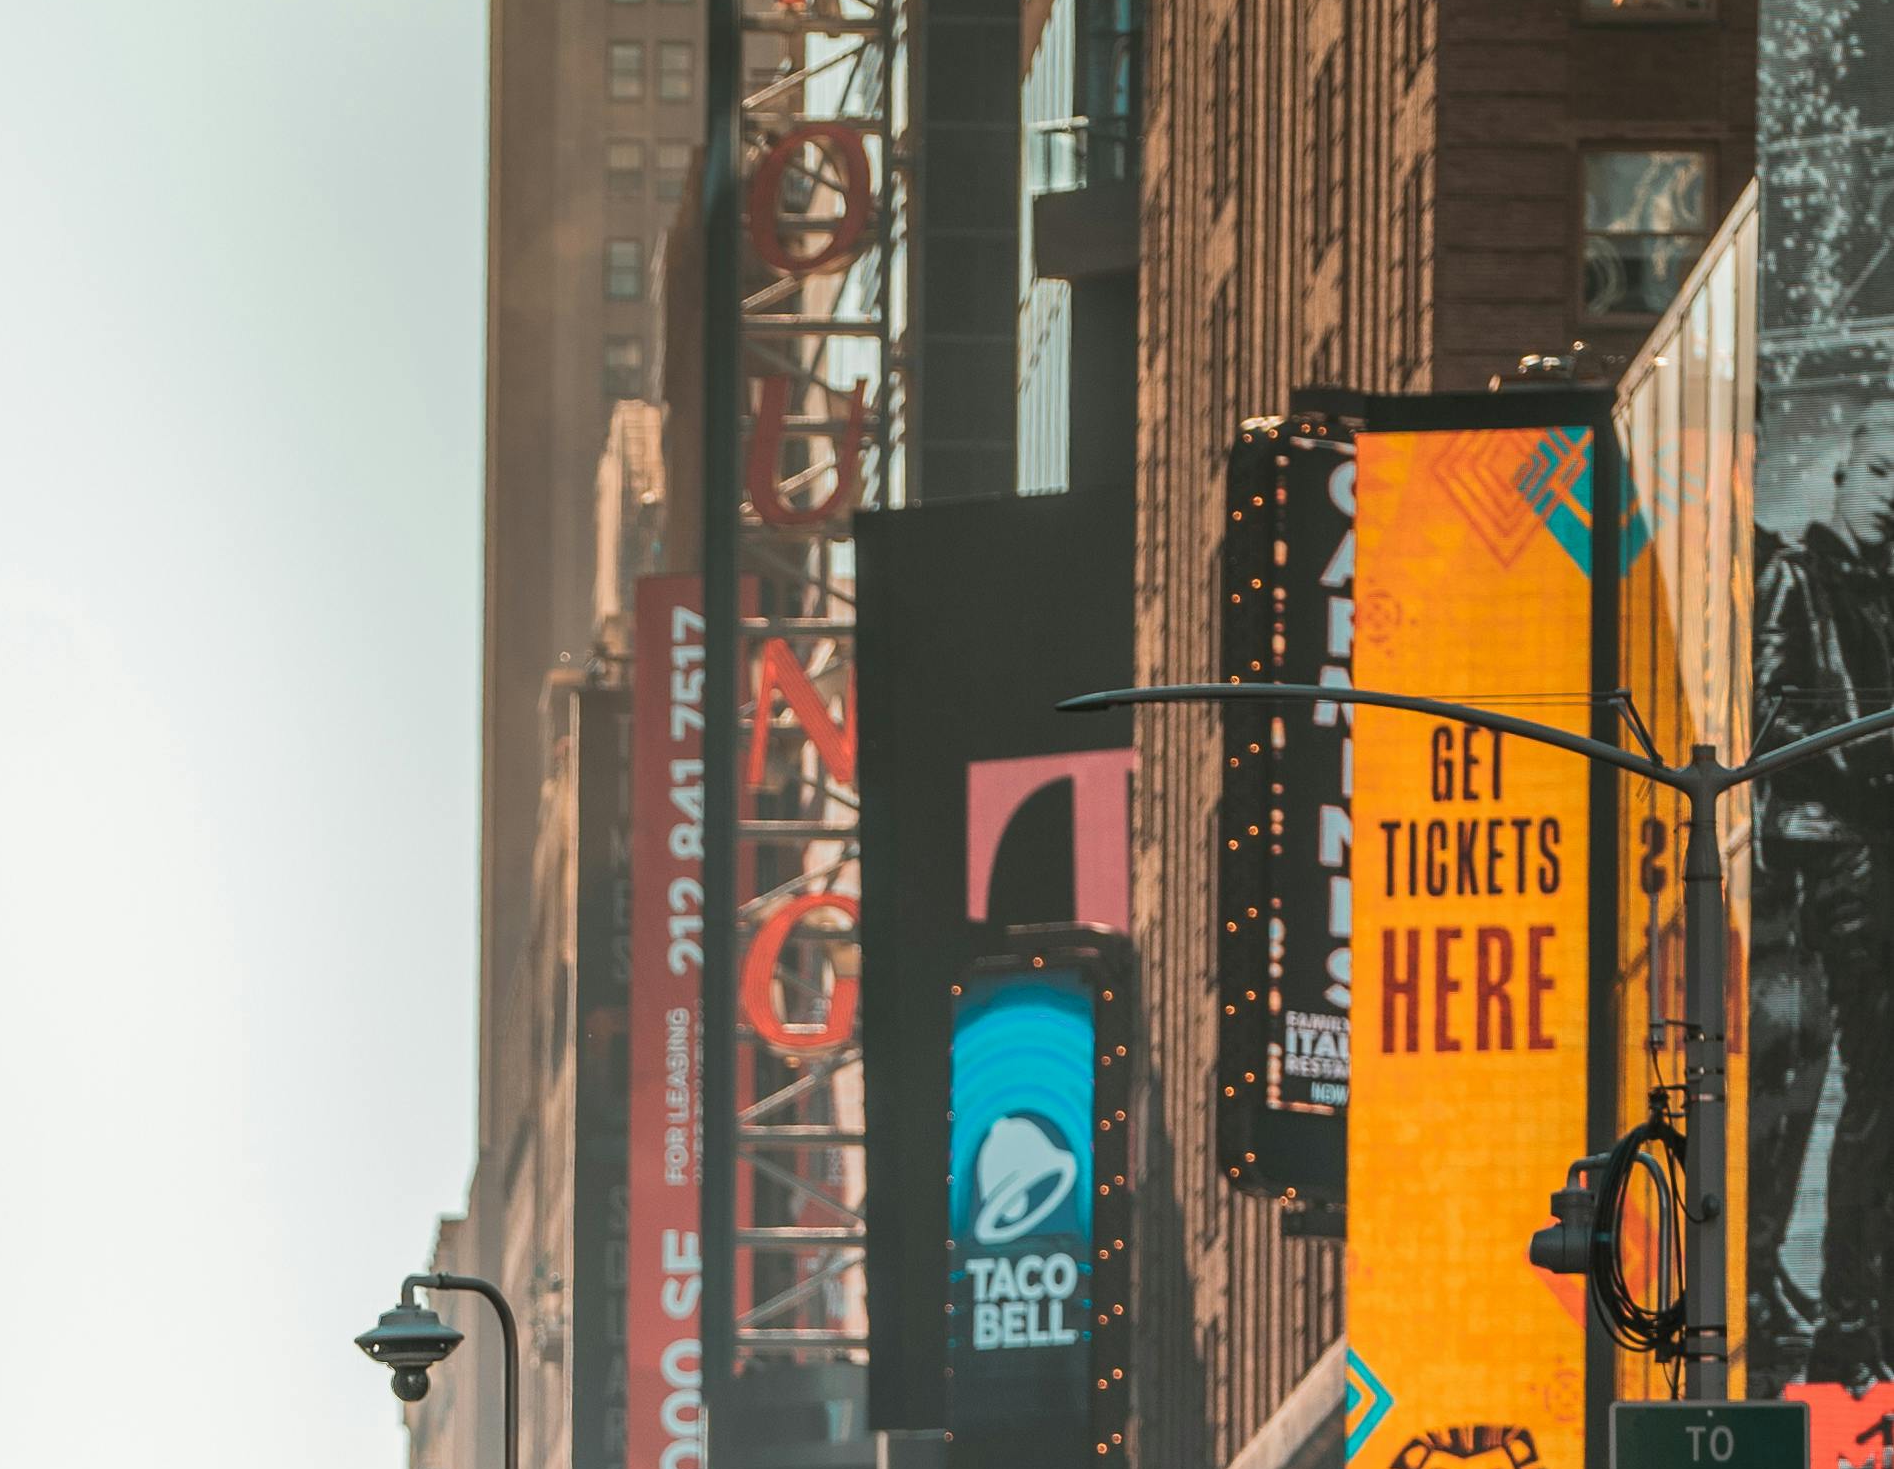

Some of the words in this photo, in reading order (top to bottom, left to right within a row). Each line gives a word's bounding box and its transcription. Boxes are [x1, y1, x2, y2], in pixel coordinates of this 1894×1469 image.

[1432, 724, 1504, 802] GET
[1380, 817, 1561, 897] TICKETS
[1380, 924, 1557, 1054] HERE
[665, 1006, 691, 1112] LEASING
[664, 1119, 689, 1187] FOR
[966, 1253, 1078, 1301] TACO
[973, 1300, 1079, 1350] BELL
[1685, 1425, 1735, 1462] TO
